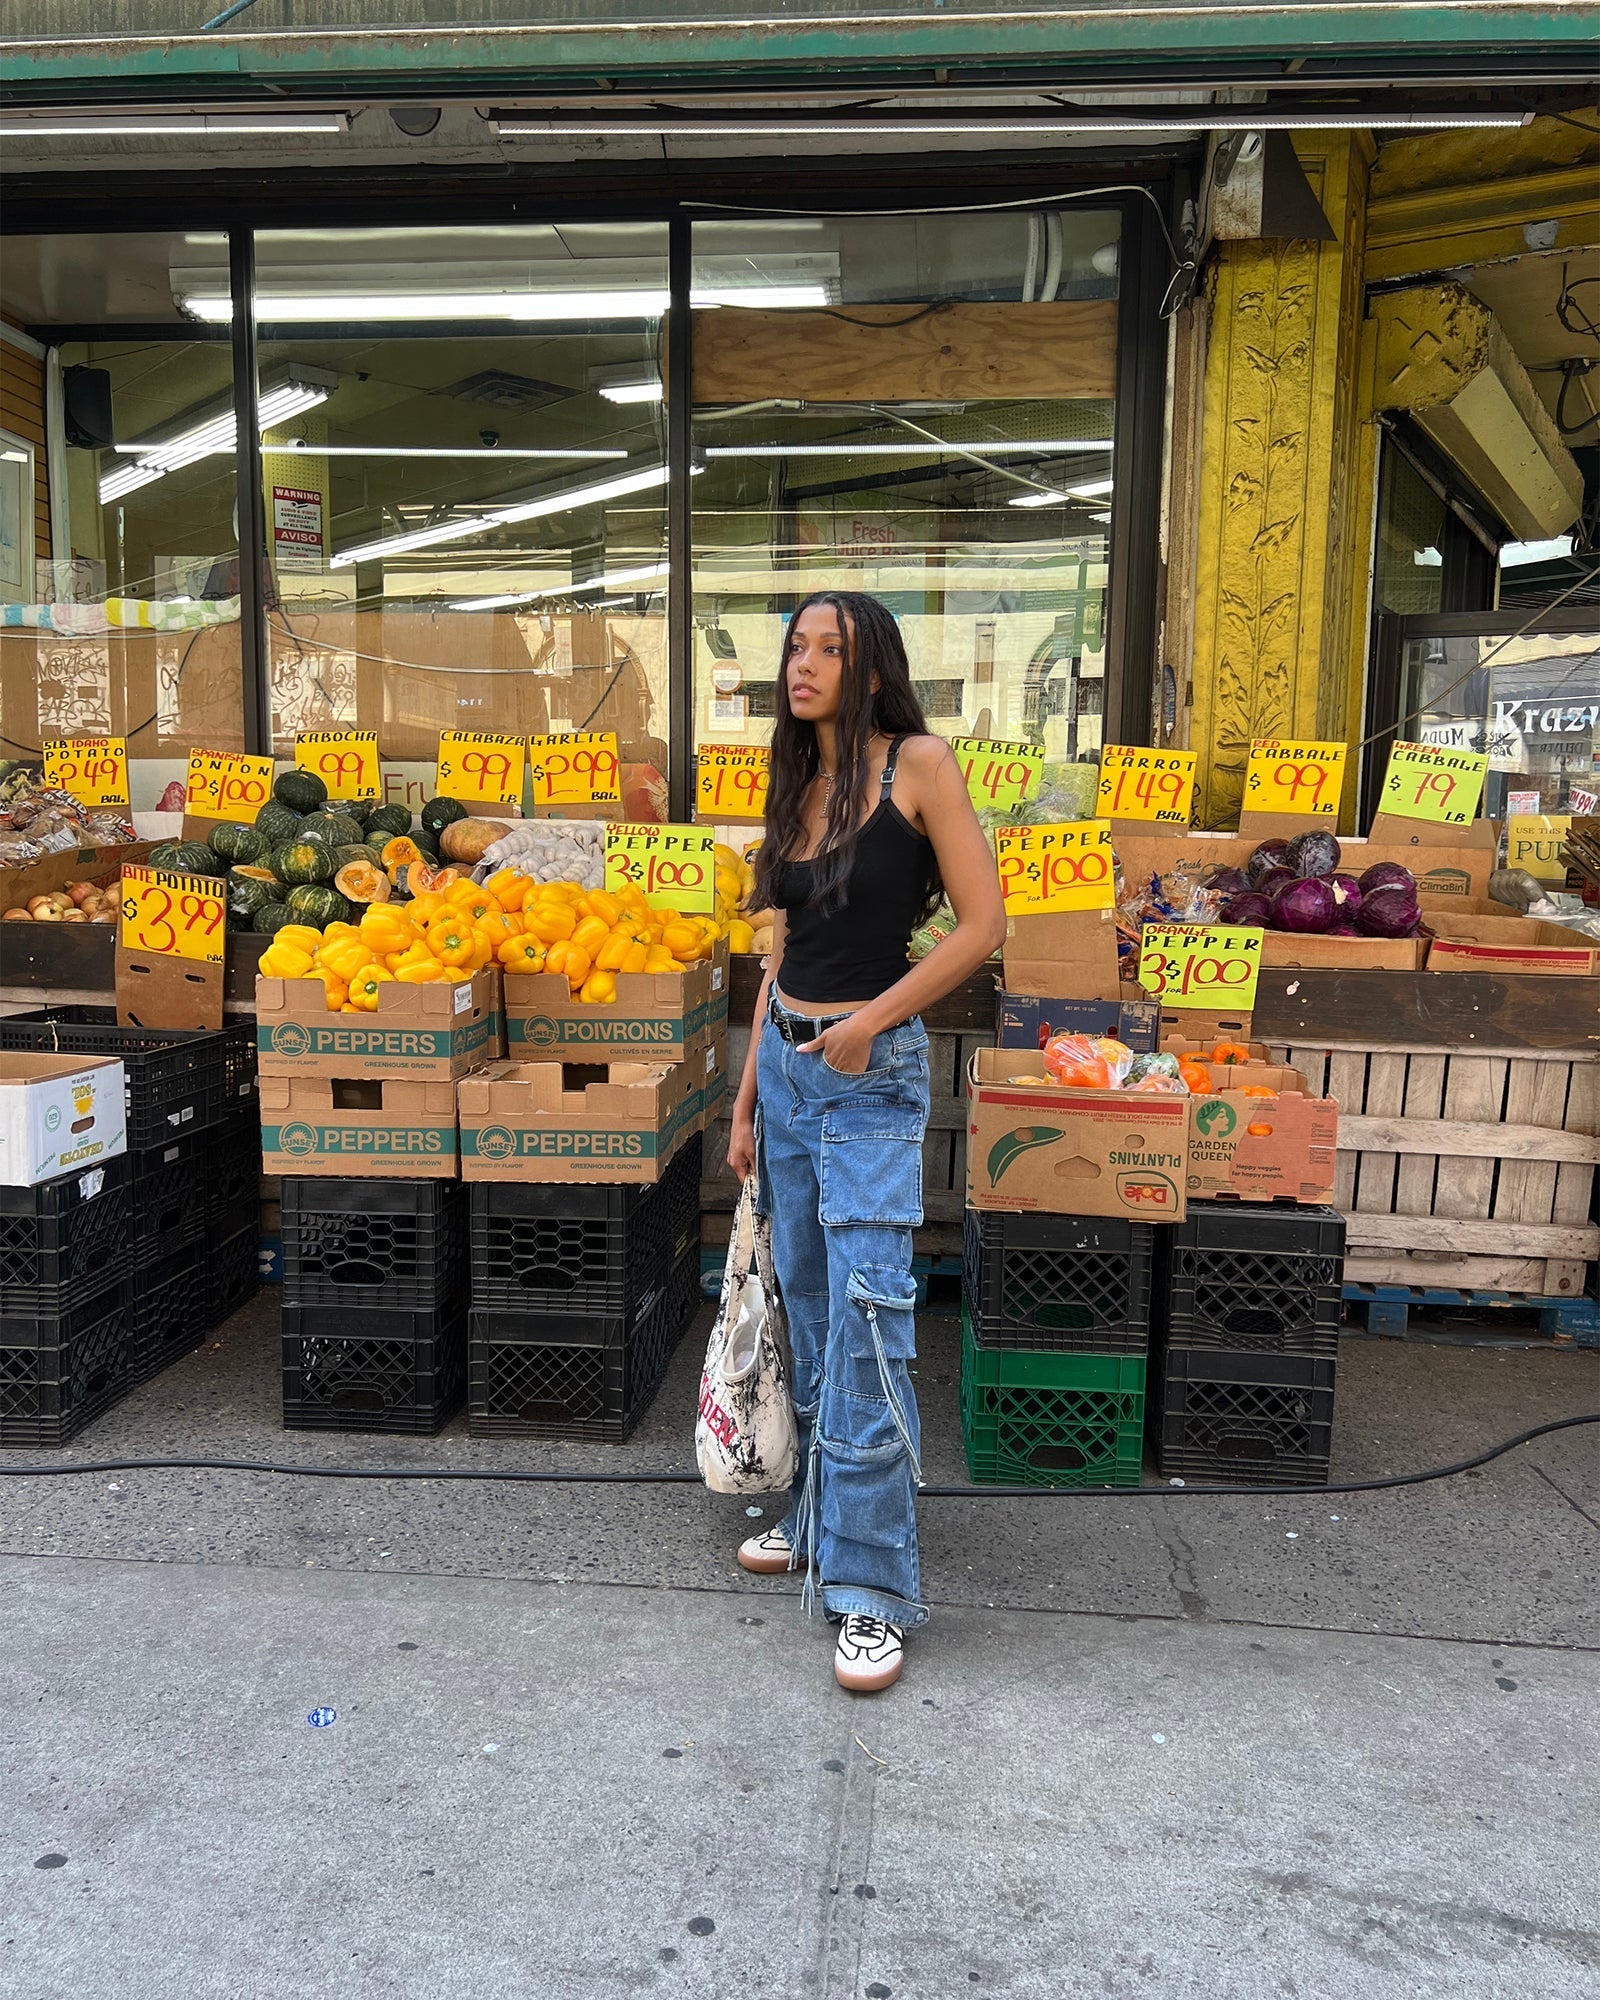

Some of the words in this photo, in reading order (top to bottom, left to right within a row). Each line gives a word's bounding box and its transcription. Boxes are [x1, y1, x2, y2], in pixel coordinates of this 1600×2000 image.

[275, 488, 320, 501] WARNING
[281, 512, 317, 521] SURVEILLANCE
[281, 531, 317, 543] AVISO
[852, 520, 896, 544] Fresh
[838, 538, 877, 560] Juice
[891, 559, 922, 568] MINERALS
[71, 738, 109, 748] IDAHO
[296, 731, 377, 744] KABOCHA
[440, 731, 525, 747] CALABAZA
[530, 733, 610, 746] GARLIC
[1253, 739, 1281, 749] RED
[45, 747, 124, 761] POTATO
[1394, 741, 1442, 755] GREEN
[191, 748, 245, 763] SPANISH
[699, 755, 769, 767] SQUAS
[1250, 748, 1344, 762] CABBAGE
[1392, 750, 1485, 772] CABBAGE
[191, 758, 270, 776] ONION
[1104, 755, 1196, 772] CARROT
[357, 787, 375, 797] LB
[384, 773, 437, 804] Fru
[499, 794, 517, 804] LB
[591, 791, 618, 801] BAG
[1312, 803, 1334, 813] LB
[1155, 810, 1187, 823] BAG
[1444, 811, 1466, 822] LB
[606, 823, 660, 836] YELLOW
[998, 827, 1032, 839] RED
[607, 836, 714, 852] PEPPER
[1000, 830, 1112, 853] PEPPER
[1175, 858, 1202, 871] Fresh
[122, 865, 153, 884] BITE
[156, 872, 223, 898] POTATO
[1419, 881, 1465, 892] ClimaBin
[1146, 925, 1211, 937] ORANGE
[1144, 935, 1260, 951] PEPPER
[526, 1030, 559, 1040] SUNSET
[564, 1021, 673, 1041] POIVRONS
[273, 1038, 311, 1049] SUNSET
[317, 1030, 436, 1054] PEPPERS
[281, 1138, 318, 1150] SUNSET
[324, 1130, 442, 1152] PEPPERS
[477, 1142, 517, 1153] SUNSET
[523, 1133, 642, 1155] PEPPERS
[1189, 1139, 1237, 1151] GARDEN
[1108, 1151, 1182, 1168] PLANTAINS
[1191, 1151, 1232, 1162] QUEEN
[1124, 1186, 1167, 1203] Dole
